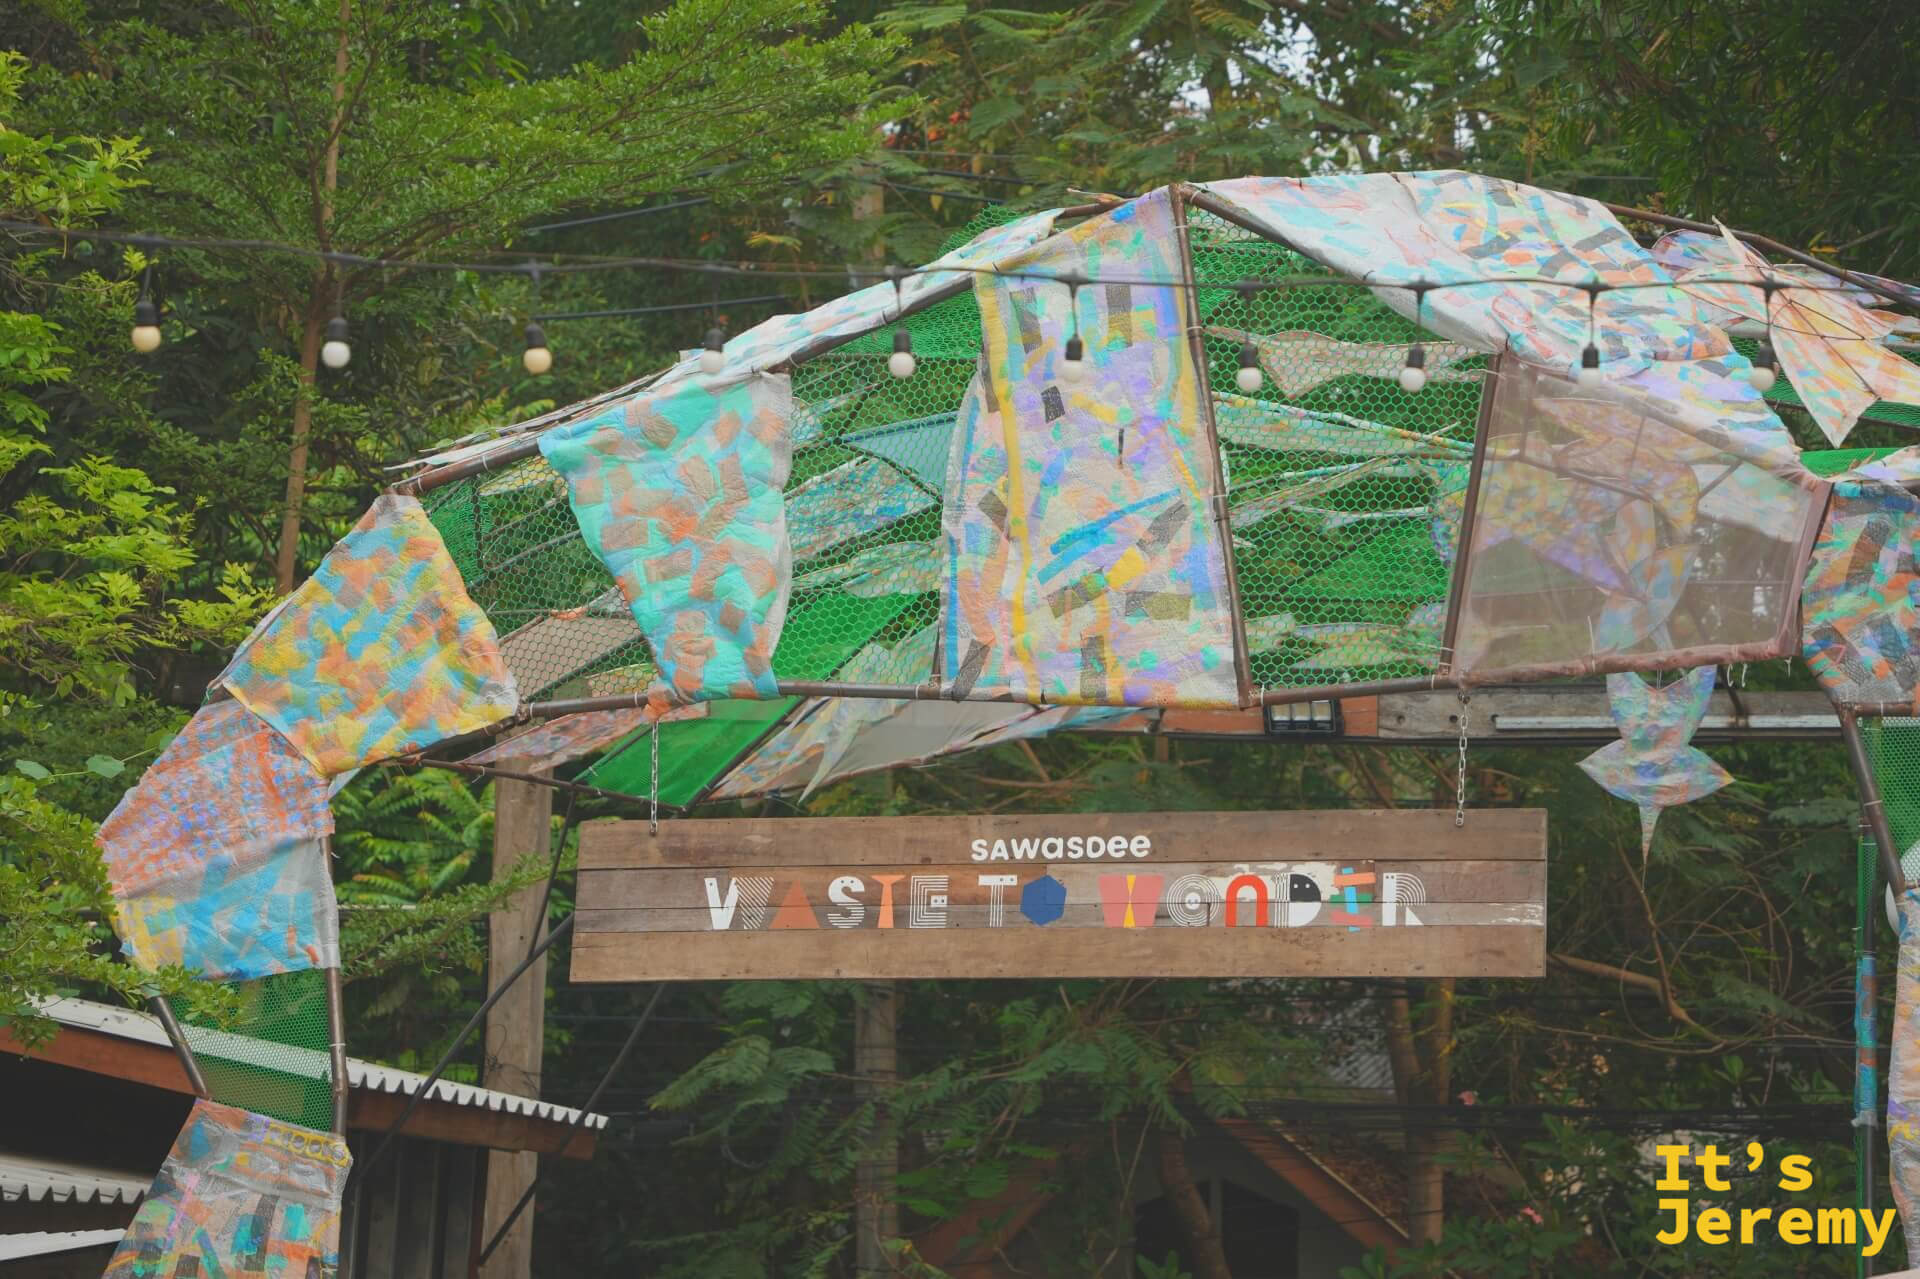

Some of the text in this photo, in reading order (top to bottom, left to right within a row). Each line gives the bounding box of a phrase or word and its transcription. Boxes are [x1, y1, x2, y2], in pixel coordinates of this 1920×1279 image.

[703, 867, 1426, 932] WASTE TO WONDER
